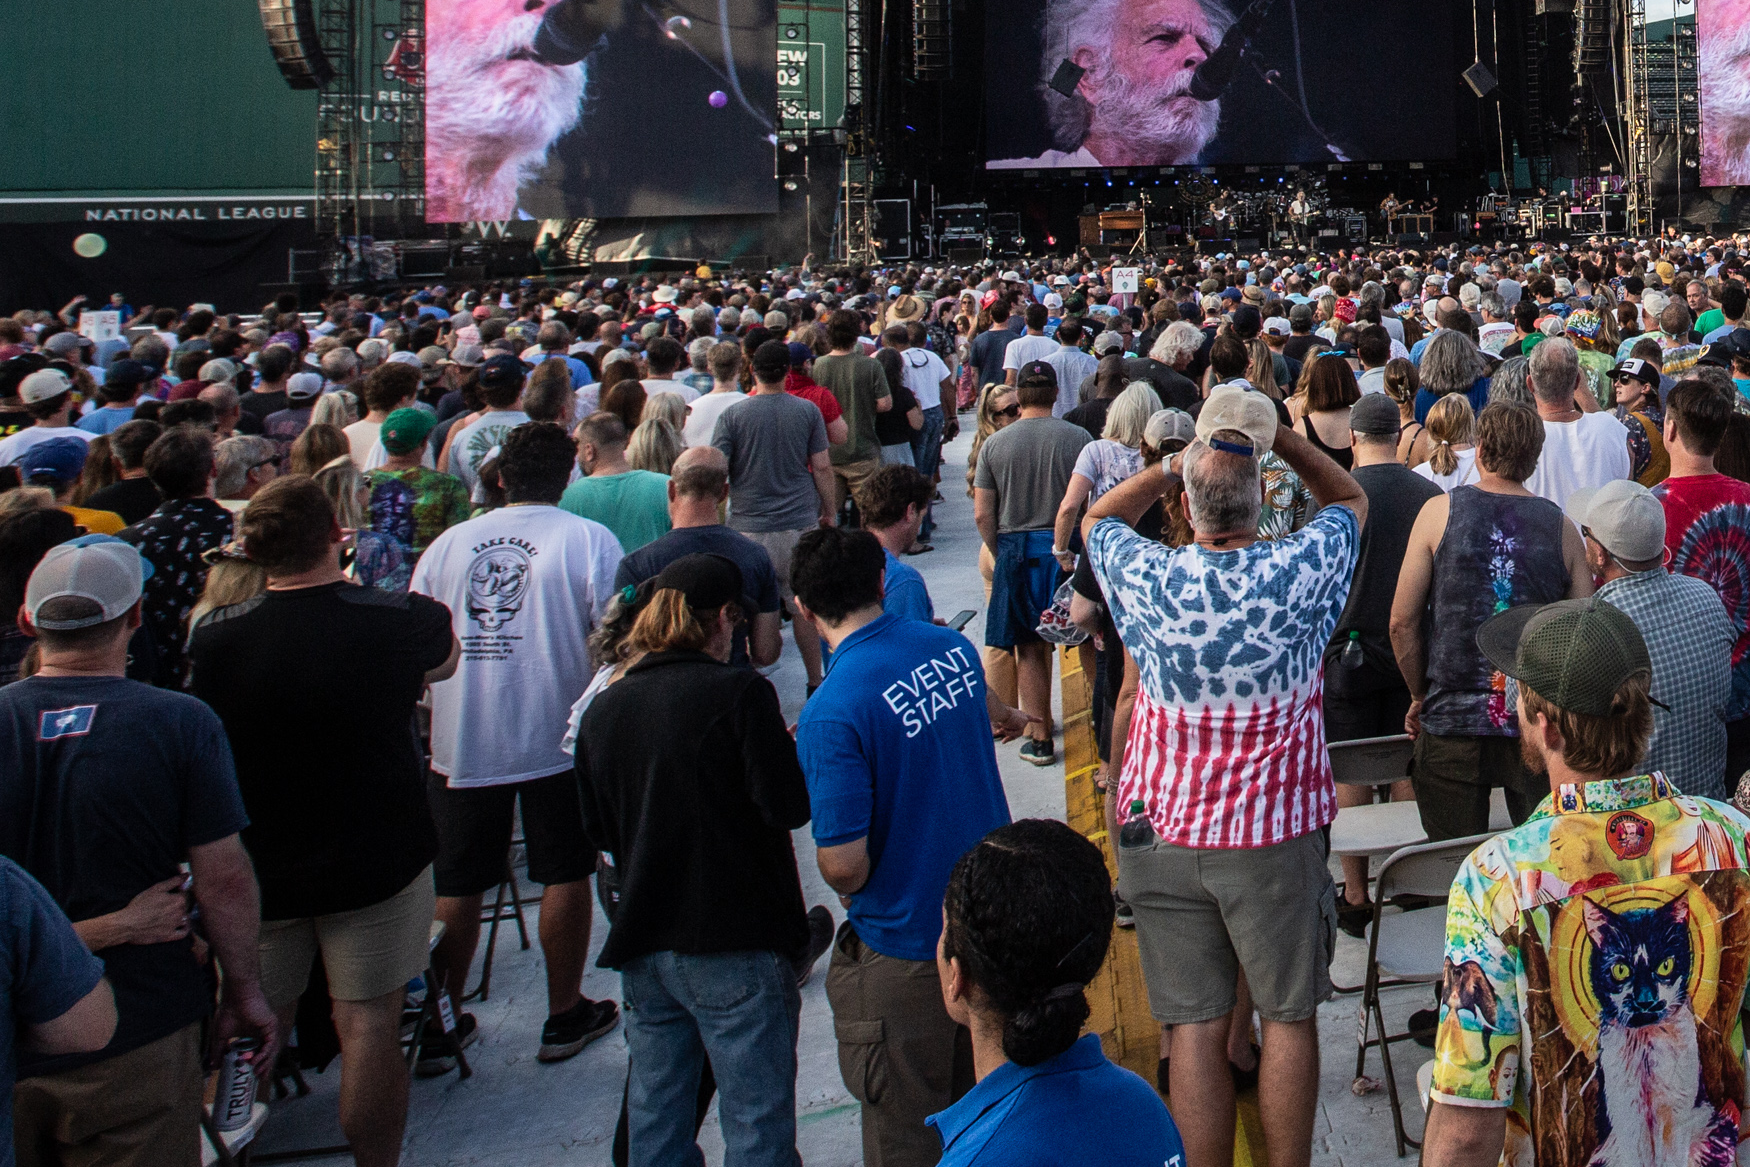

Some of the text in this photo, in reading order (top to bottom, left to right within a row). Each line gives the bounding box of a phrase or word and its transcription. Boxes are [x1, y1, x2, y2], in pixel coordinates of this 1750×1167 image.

[777, 49, 807, 66] EW
[84, 206, 306, 222] NATIONAL LEAGUE
[1116, 270, 1134, 278] A4
[101, 314, 118, 325] A5
[472, 537, 538, 557] TAKE CARE!
[882, 647, 970, 714] EVENT
[902, 670, 978, 738] STAFF
[227, 1068, 250, 1121] TRULY
